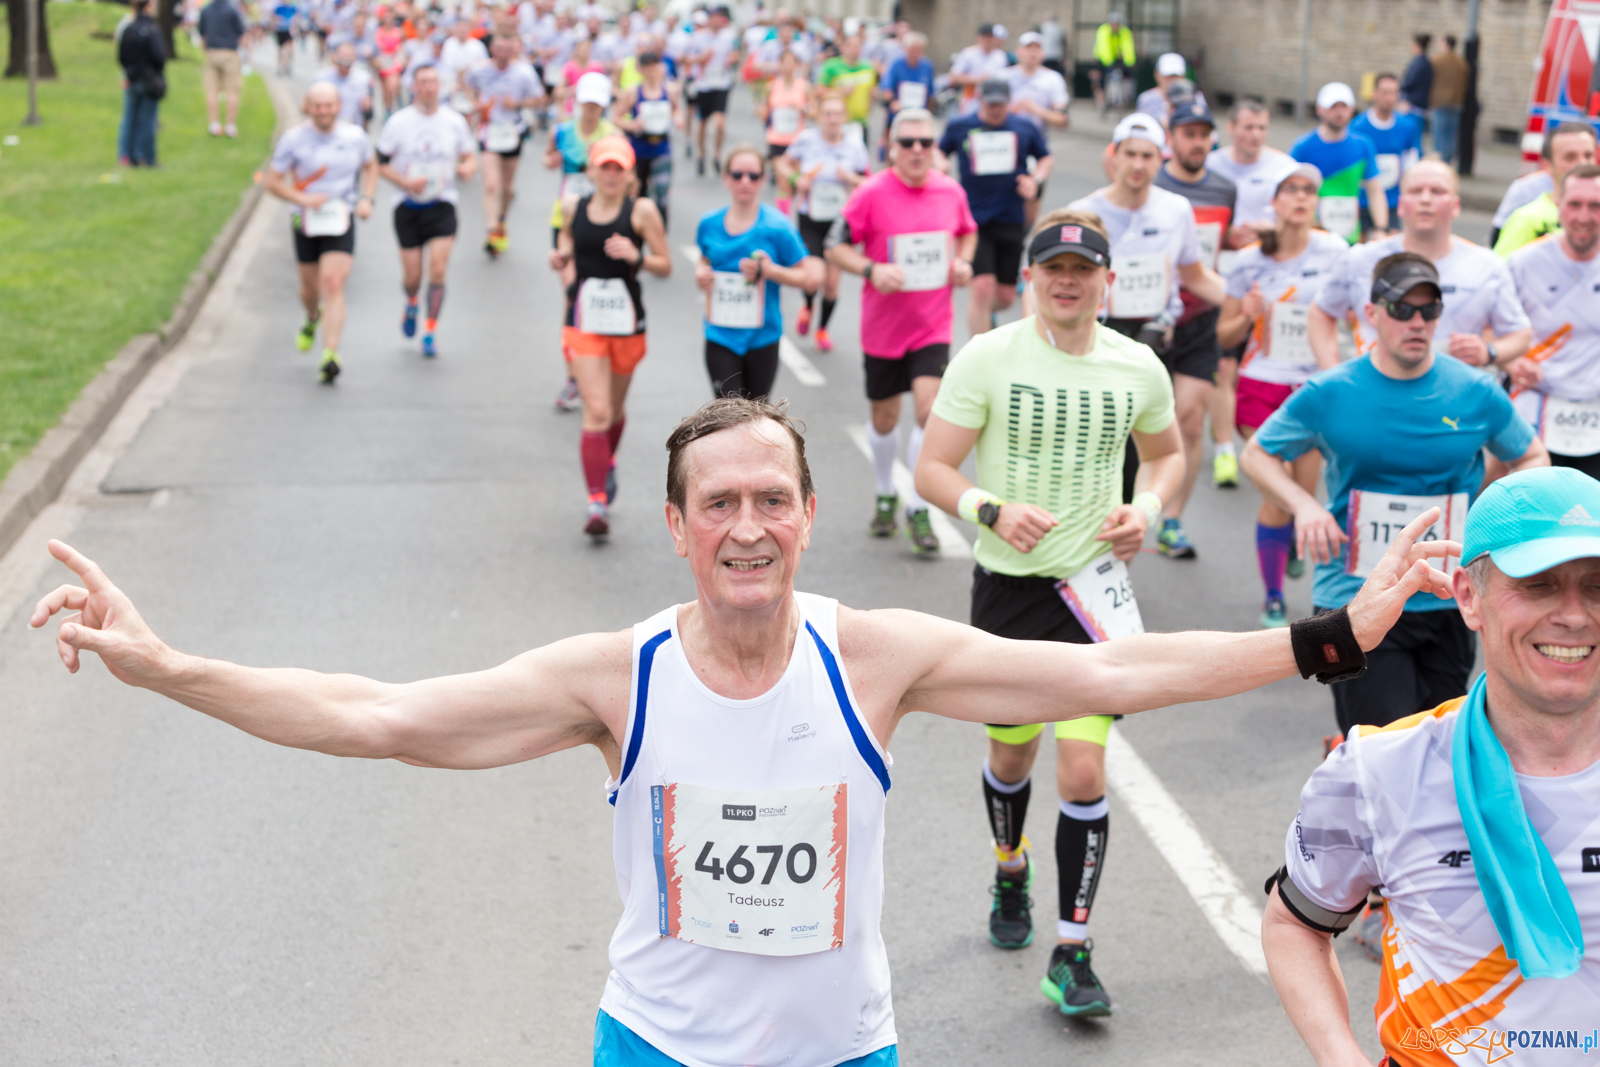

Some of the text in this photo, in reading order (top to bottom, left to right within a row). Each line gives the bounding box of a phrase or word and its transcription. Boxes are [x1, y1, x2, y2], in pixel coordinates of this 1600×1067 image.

[1555, 410, 1600, 428] 6692
[1371, 522, 1438, 543] 1176
[1105, 576, 1133, 609] 26
[736, 809, 753, 817] PKO
[694, 840, 817, 885] 4670
[727, 892, 785, 907] Tadeusz
